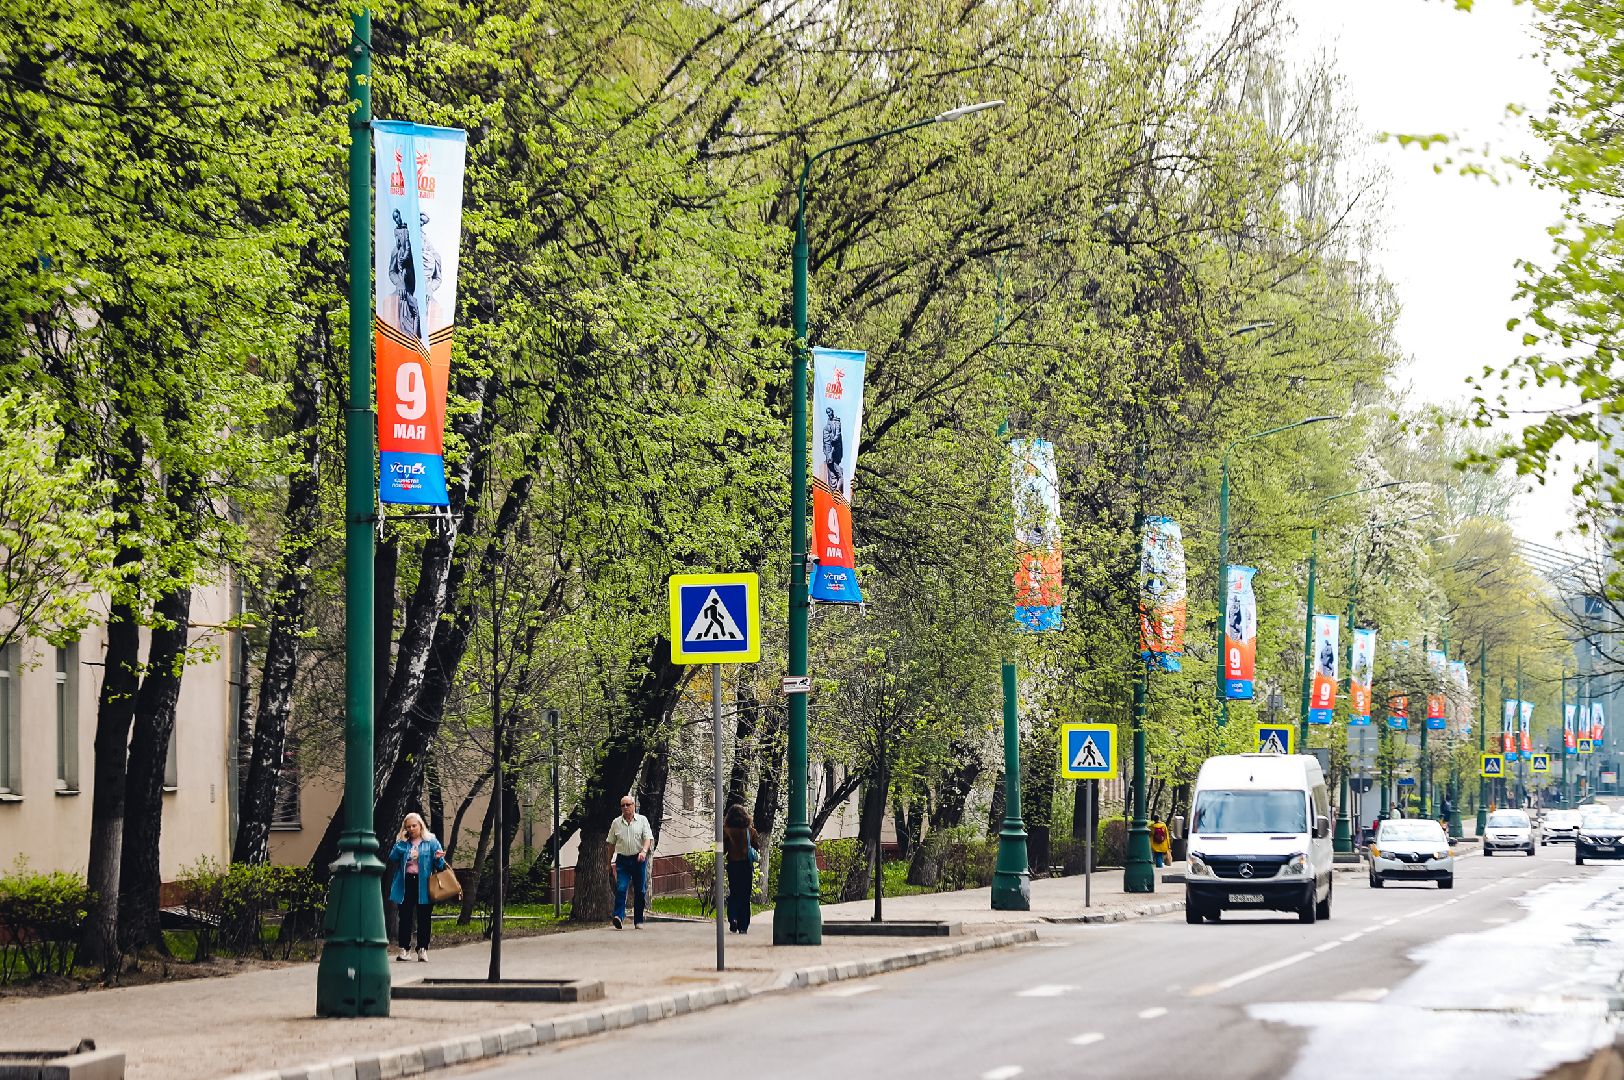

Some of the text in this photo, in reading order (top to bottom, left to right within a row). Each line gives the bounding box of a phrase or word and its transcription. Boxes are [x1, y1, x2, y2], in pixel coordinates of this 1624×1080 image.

[395, 362, 427, 420] 9
[393, 424, 426, 440] МАЯ
[389, 464, 426, 474] УСПЕХ
[827, 507, 840, 545] 9
[1229, 647, 1241, 669] 9
[1320, 682, 1331, 701] 9
